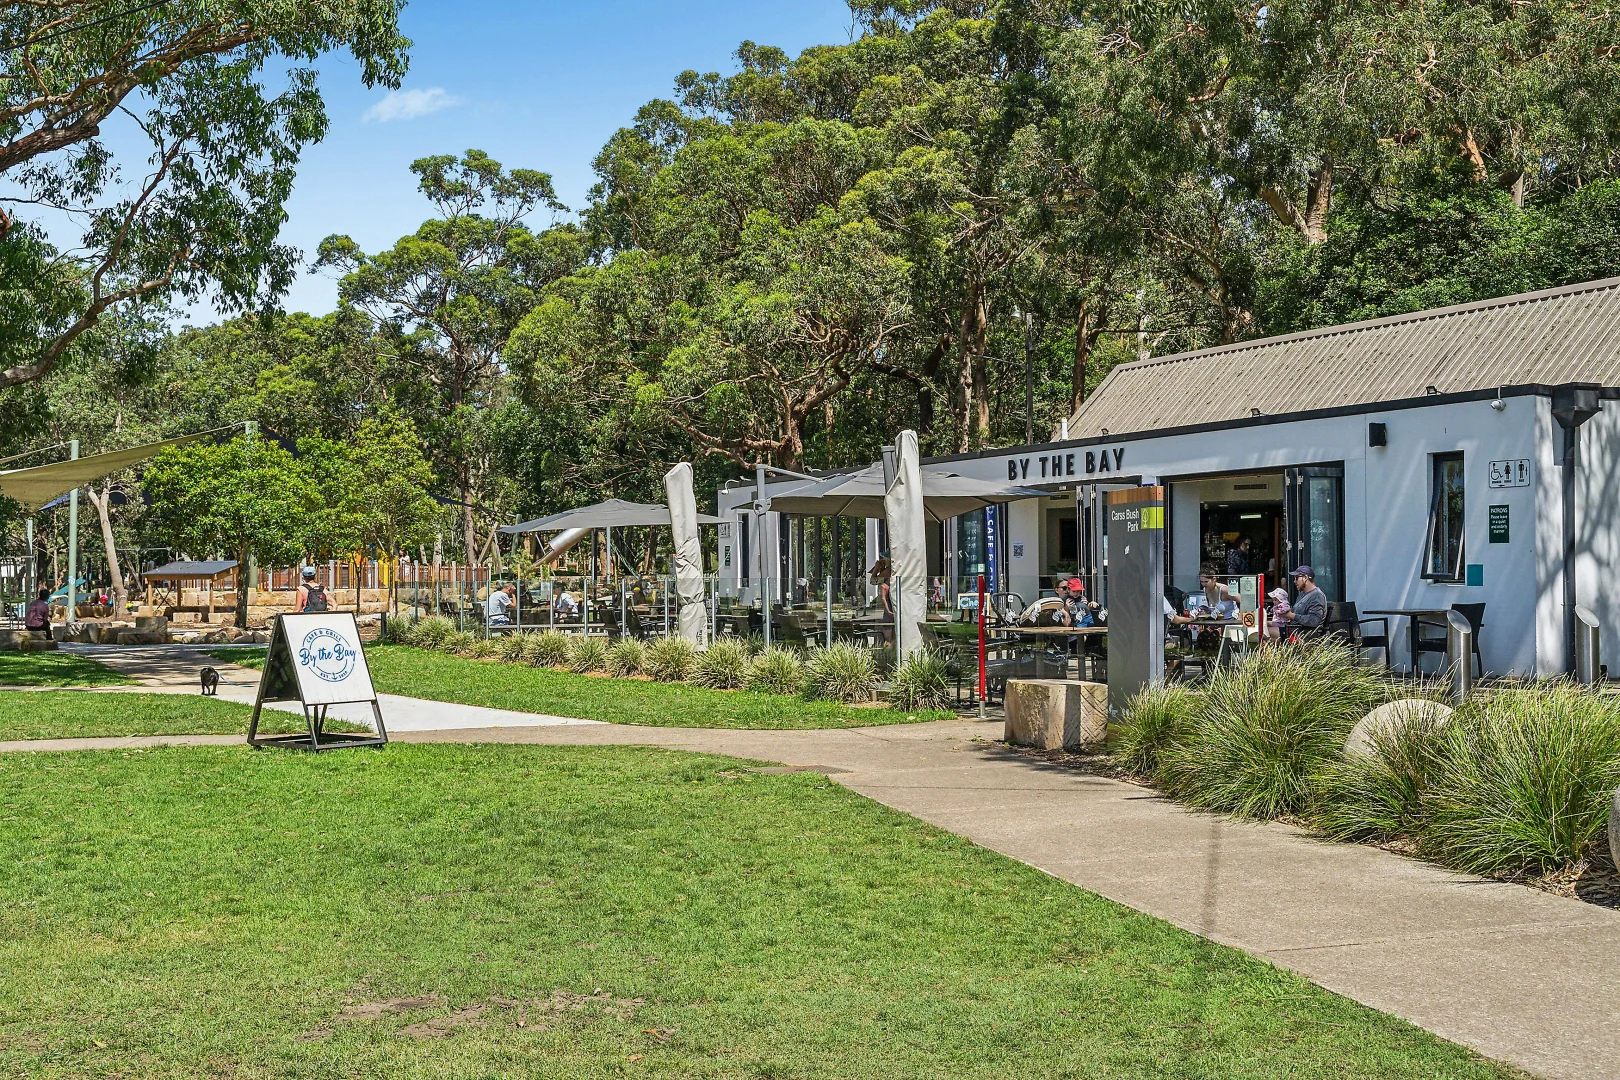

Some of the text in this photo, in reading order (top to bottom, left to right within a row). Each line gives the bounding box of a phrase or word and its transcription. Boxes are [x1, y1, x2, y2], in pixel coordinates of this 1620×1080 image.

[1008, 447, 1125, 481] BY THE BAY
[1111, 508, 1140, 521] Carss Bush
[1127, 520, 1140, 532] Park
[299, 643, 356, 667] By the Bay
